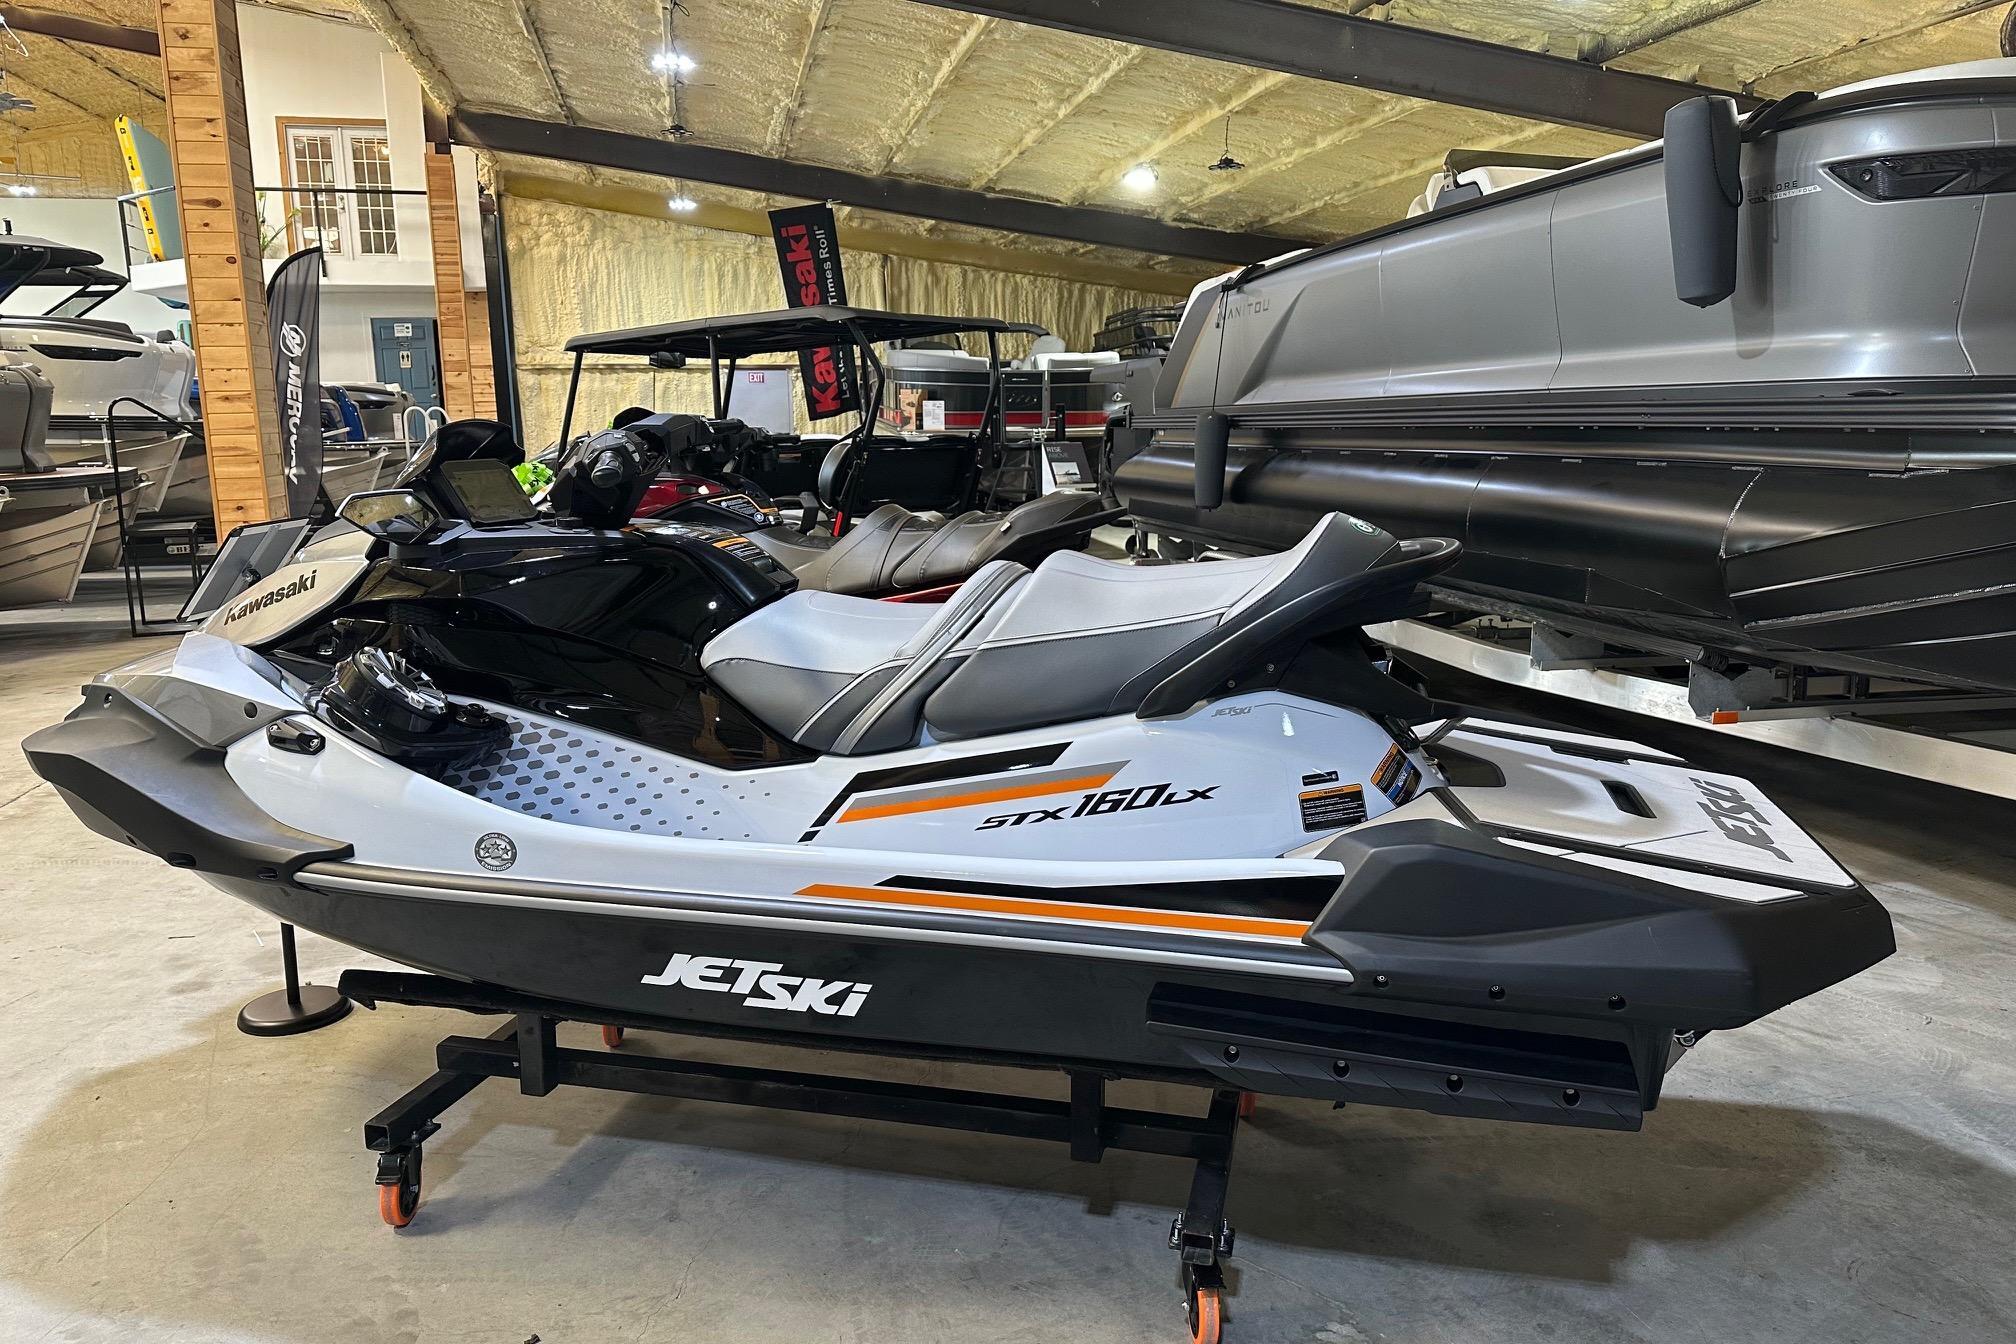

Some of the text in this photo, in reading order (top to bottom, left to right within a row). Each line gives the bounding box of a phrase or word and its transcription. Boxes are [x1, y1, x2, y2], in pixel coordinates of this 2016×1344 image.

[1747, 181, 1798, 197] EXPLORE
[780, 224, 841, 413] Kawsaki
[749, 373, 765, 383] EXIT
[223, 569, 318, 625] Kawasaki
